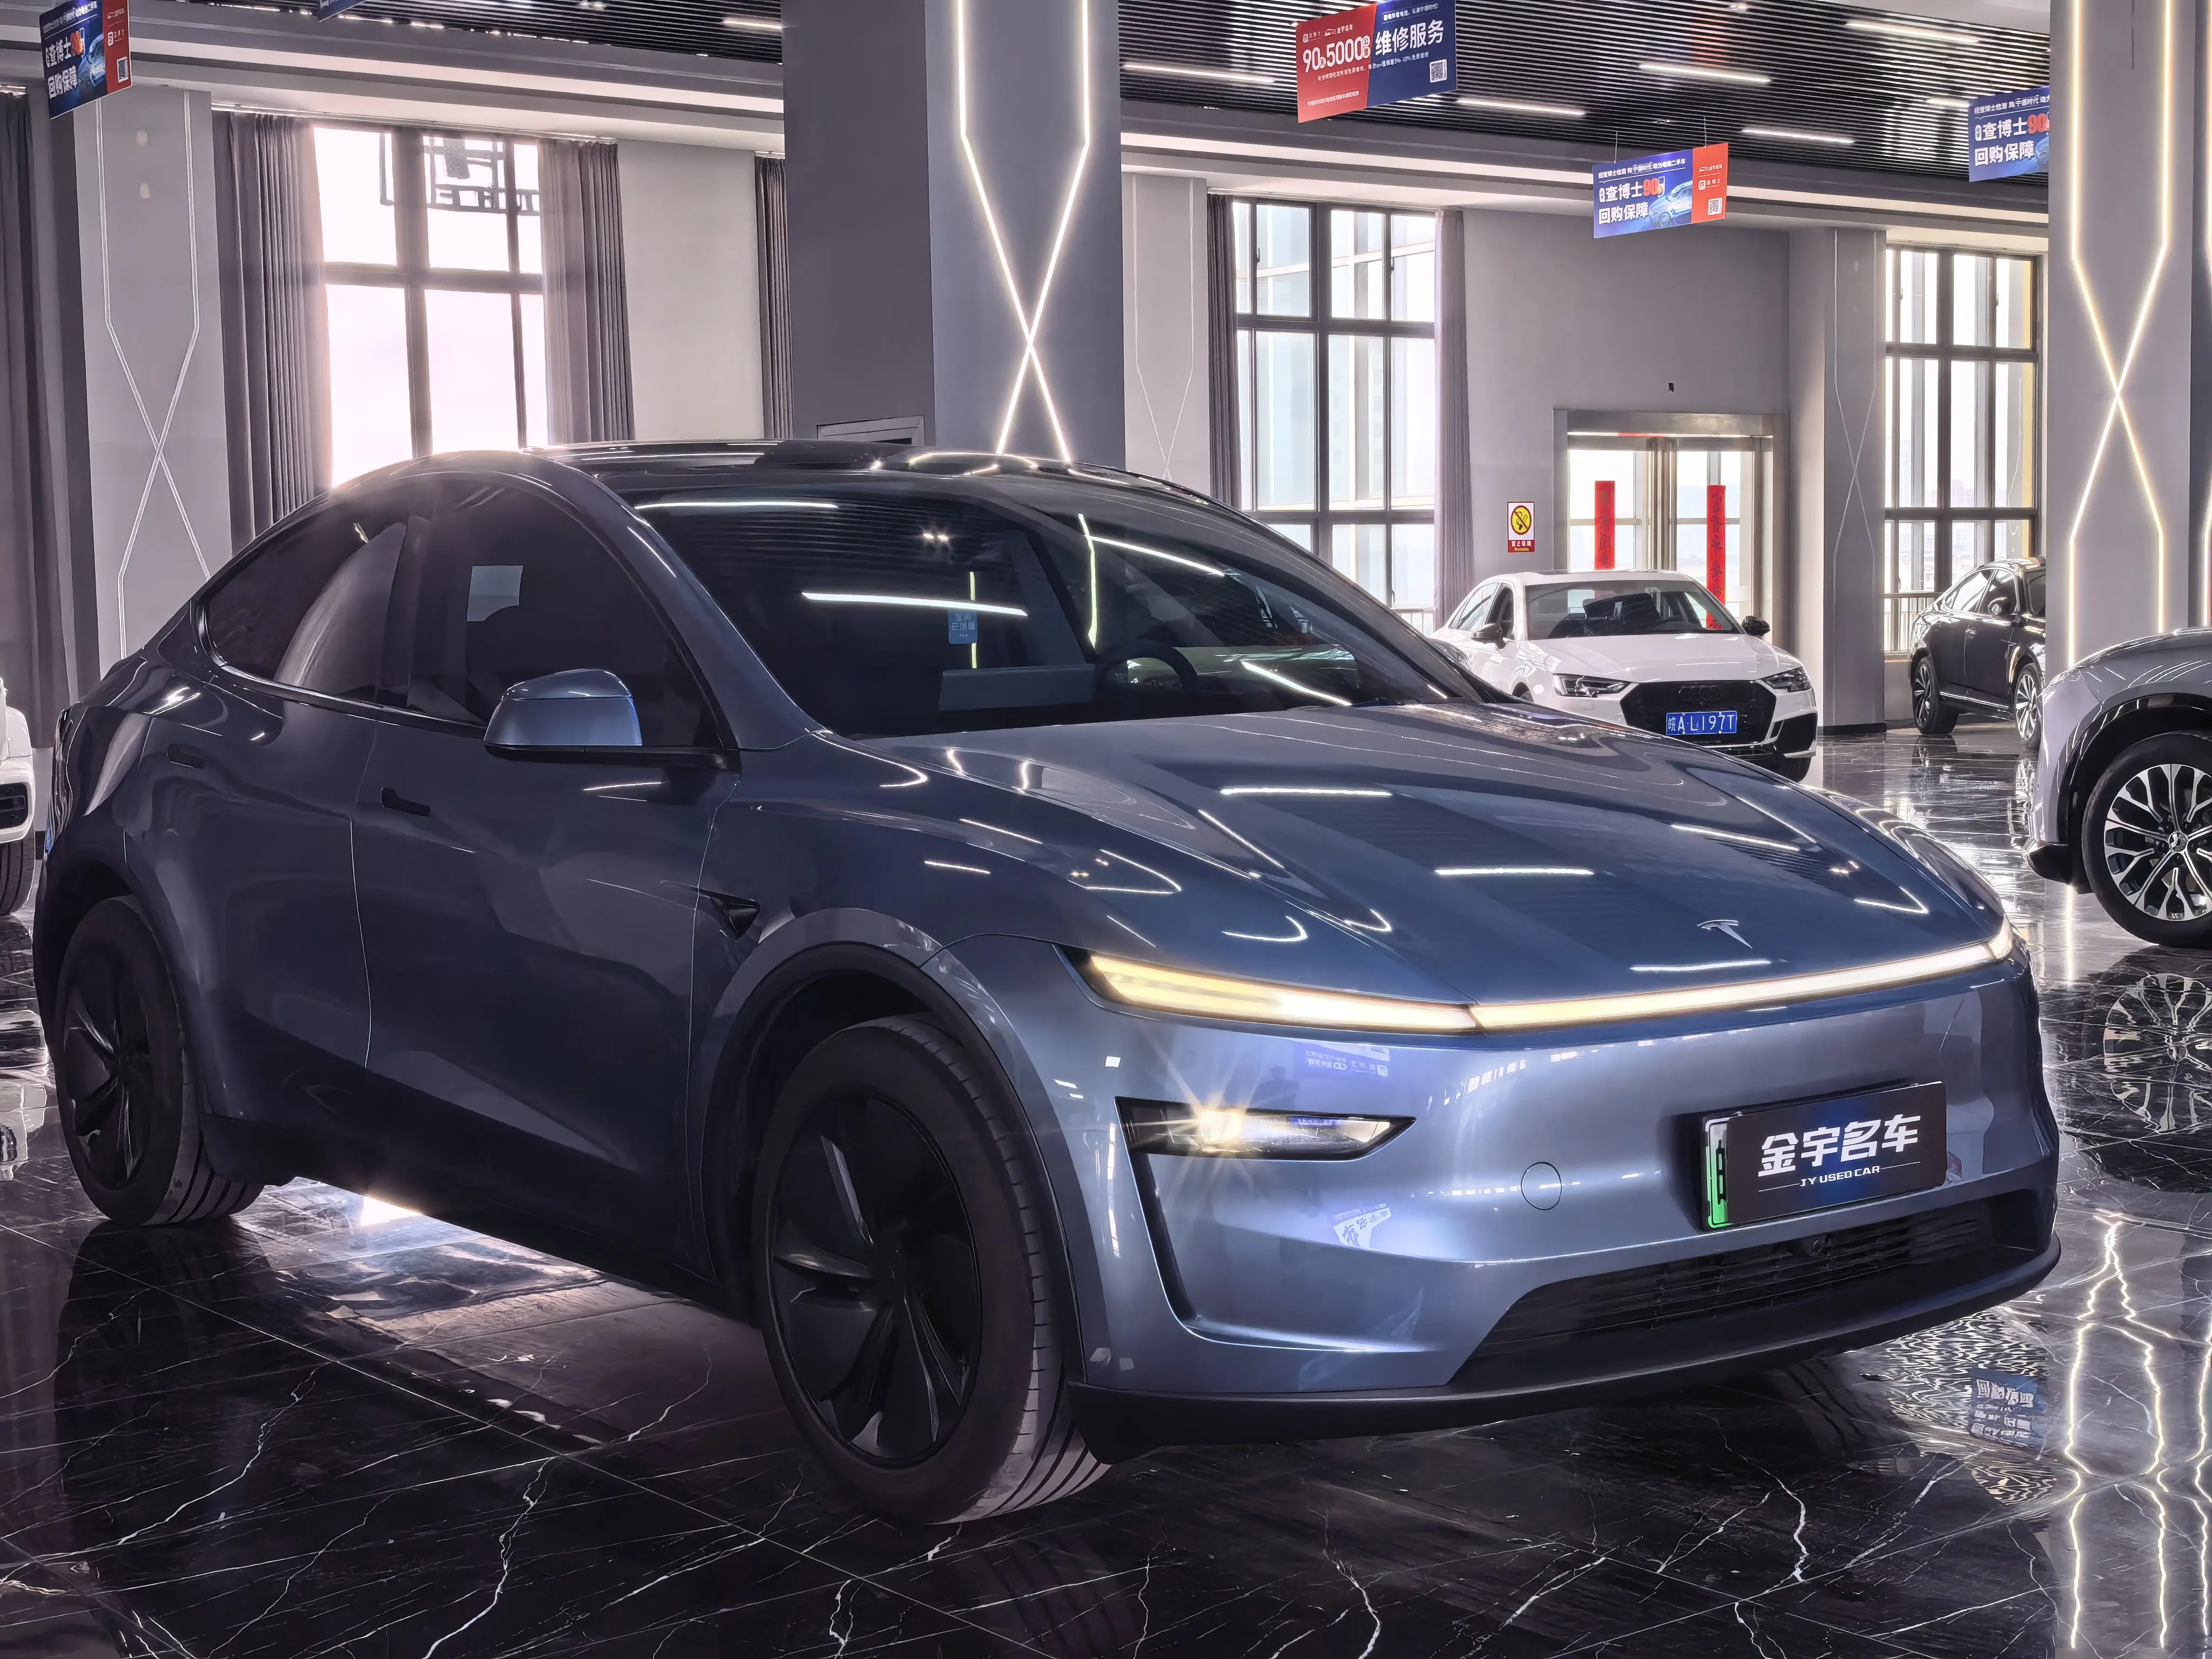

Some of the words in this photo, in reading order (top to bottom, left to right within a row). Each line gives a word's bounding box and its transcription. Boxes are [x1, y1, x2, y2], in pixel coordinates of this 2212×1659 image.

[1375, 20, 1444, 56] 维修服务
[1975, 140, 2034, 166] 回购保障
[1599, 202, 1649, 225] 回购保障
[1758, 1114, 1921, 1177] 金宇名车
[1800, 1176, 1817, 1187] JY
[1819, 1170, 1852, 1184] USED
[1854, 1165, 1880, 1177] CAR
